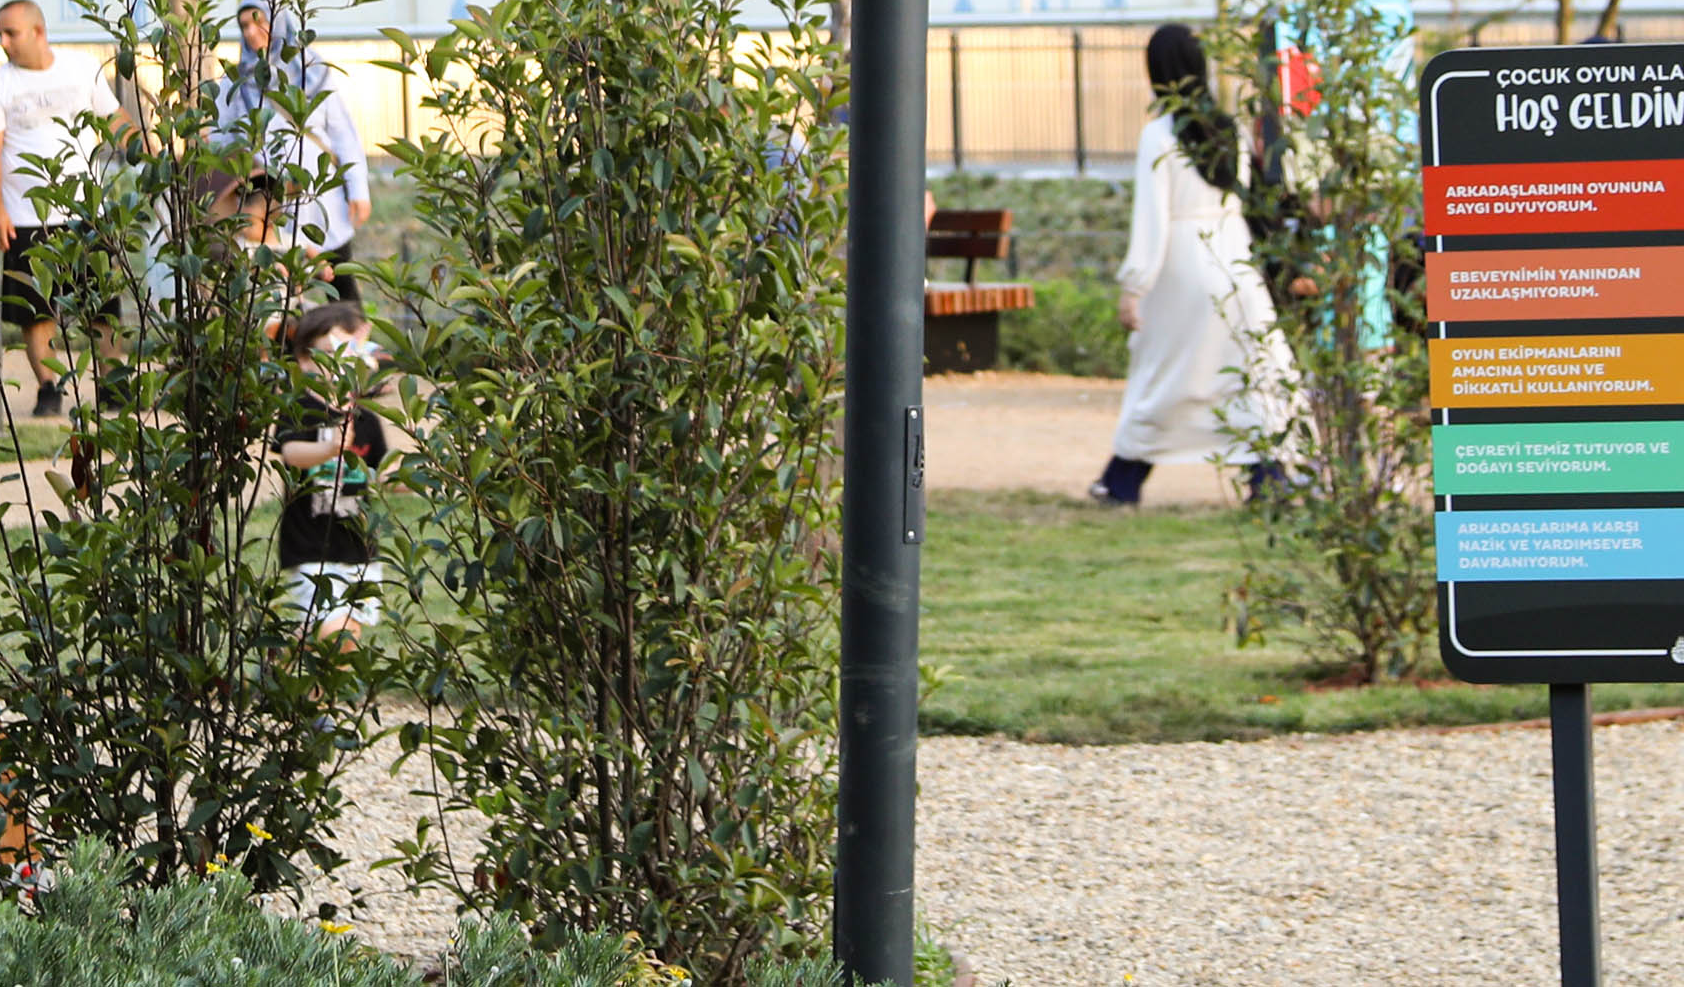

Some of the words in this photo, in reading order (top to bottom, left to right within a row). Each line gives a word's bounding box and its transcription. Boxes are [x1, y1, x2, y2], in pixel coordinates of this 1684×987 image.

[1496, 67, 1571, 88] ÇOCUK
[1576, 65, 1635, 83] OYUN
[1496, 93, 1559, 137] HOŞ
[1445, 183, 1584, 199] ARKADAŞLARIMIN
[1586, 181, 1665, 195] OYUNUNA
[1446, 202, 1491, 216] SAYGI
[1493, 200, 1598, 214] DUYUYORUM.
[1449, 267, 1556, 284] EBEVEYNİMİN
[1559, 267, 1641, 280] YANINDAN
[1450, 286, 1600, 301] UZAKLAŞMIYORUM.
[1451, 349, 1495, 361] OYUN
[1498, 345, 1622, 360] EKİPMANLARINI
[1452, 364, 1523, 378] AMACINA
[1526, 364, 1581, 376] UYGUN
[1583, 363, 1605, 375] VE
[1453, 379, 1524, 395] DİKKATLİ
[1526, 380, 1655, 394] KULLANIYORUM.
[1455, 441, 1522, 459] ÇEVREYİ
[1524, 440, 1570, 455] TEMİZ
[1573, 442, 1647, 455] TUTUYOR
[1649, 442, 1670, 454] VE
[1456, 459, 1513, 474] DOĞAYI
[1516, 457, 1611, 473] SEVİYORUM.
[1457, 521, 1589, 536] ARKADAŞLARIMA
[1592, 520, 1639, 535] KARŞI
[1459, 537, 1505, 552] NAZİK
[1508, 539, 1529, 551] VE
[1532, 538, 1643, 551] YARDIMSEVER
[1459, 555, 1588, 569] DAVRANIYORUM.
